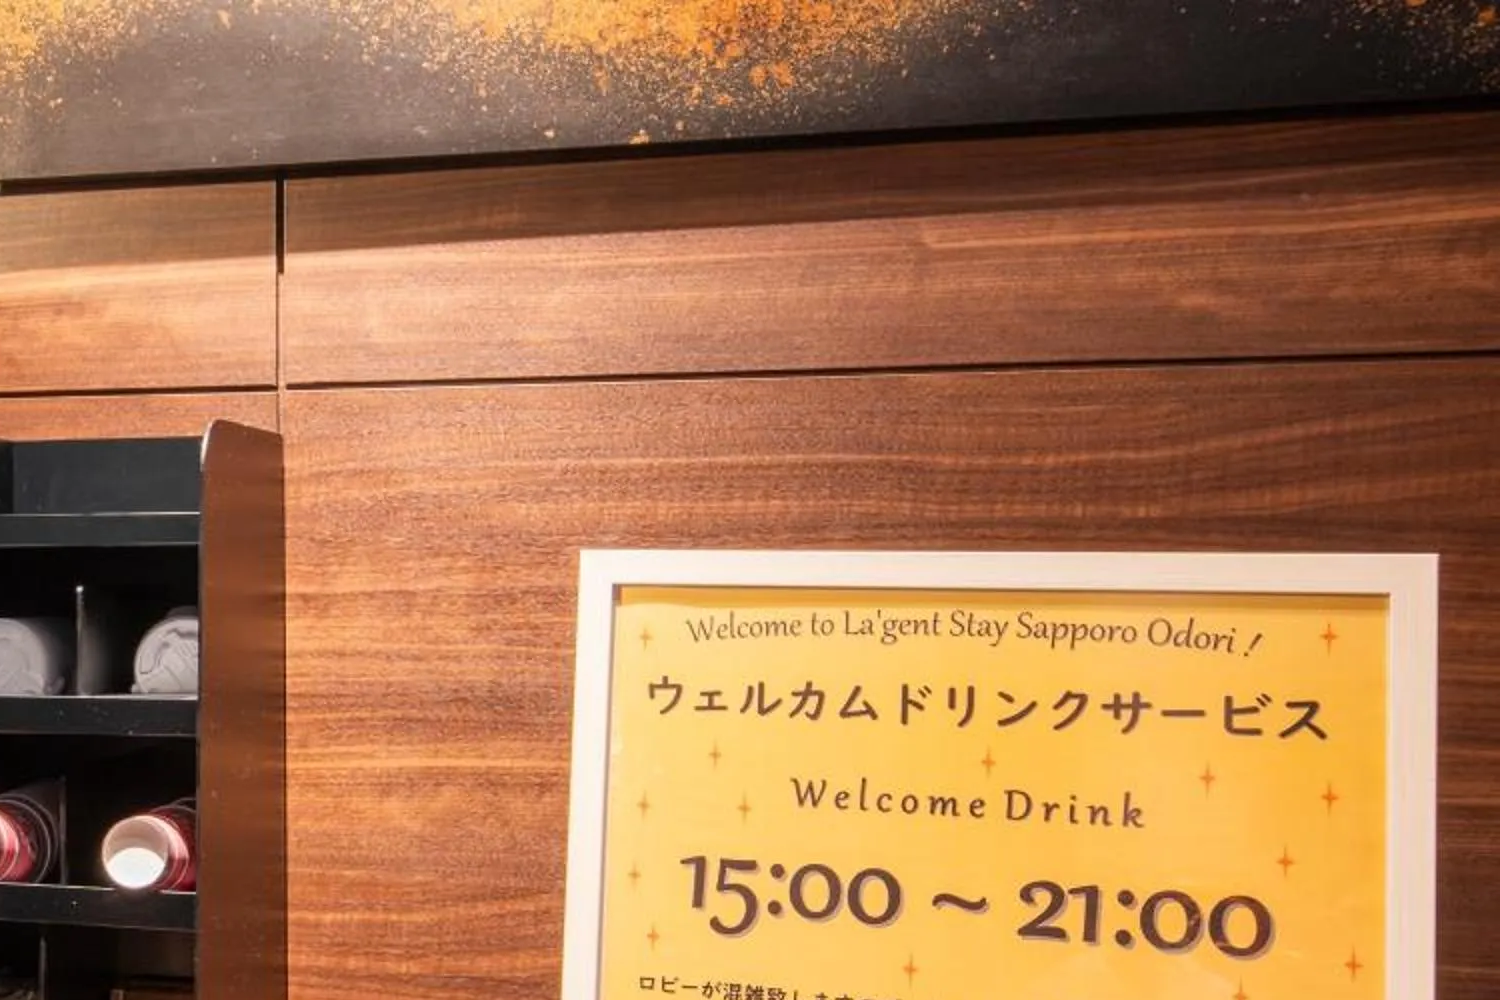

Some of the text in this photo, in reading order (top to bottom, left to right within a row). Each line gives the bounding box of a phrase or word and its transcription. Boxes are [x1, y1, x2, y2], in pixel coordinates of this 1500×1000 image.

[686, 611, 801, 643] Welcome
[810, 615, 835, 637] to
[844, 609, 941, 645] La'gent
[949, 610, 1008, 647] Stay
[1015, 611, 1138, 650] Sapporo
[648, 675, 1328, 740] ウェルカムドリンクサービス
[790, 777, 1145, 829] Welcome Drink
[680, 854, 903, 937] 15:00
[1017, 879, 1275, 960] 21:00
